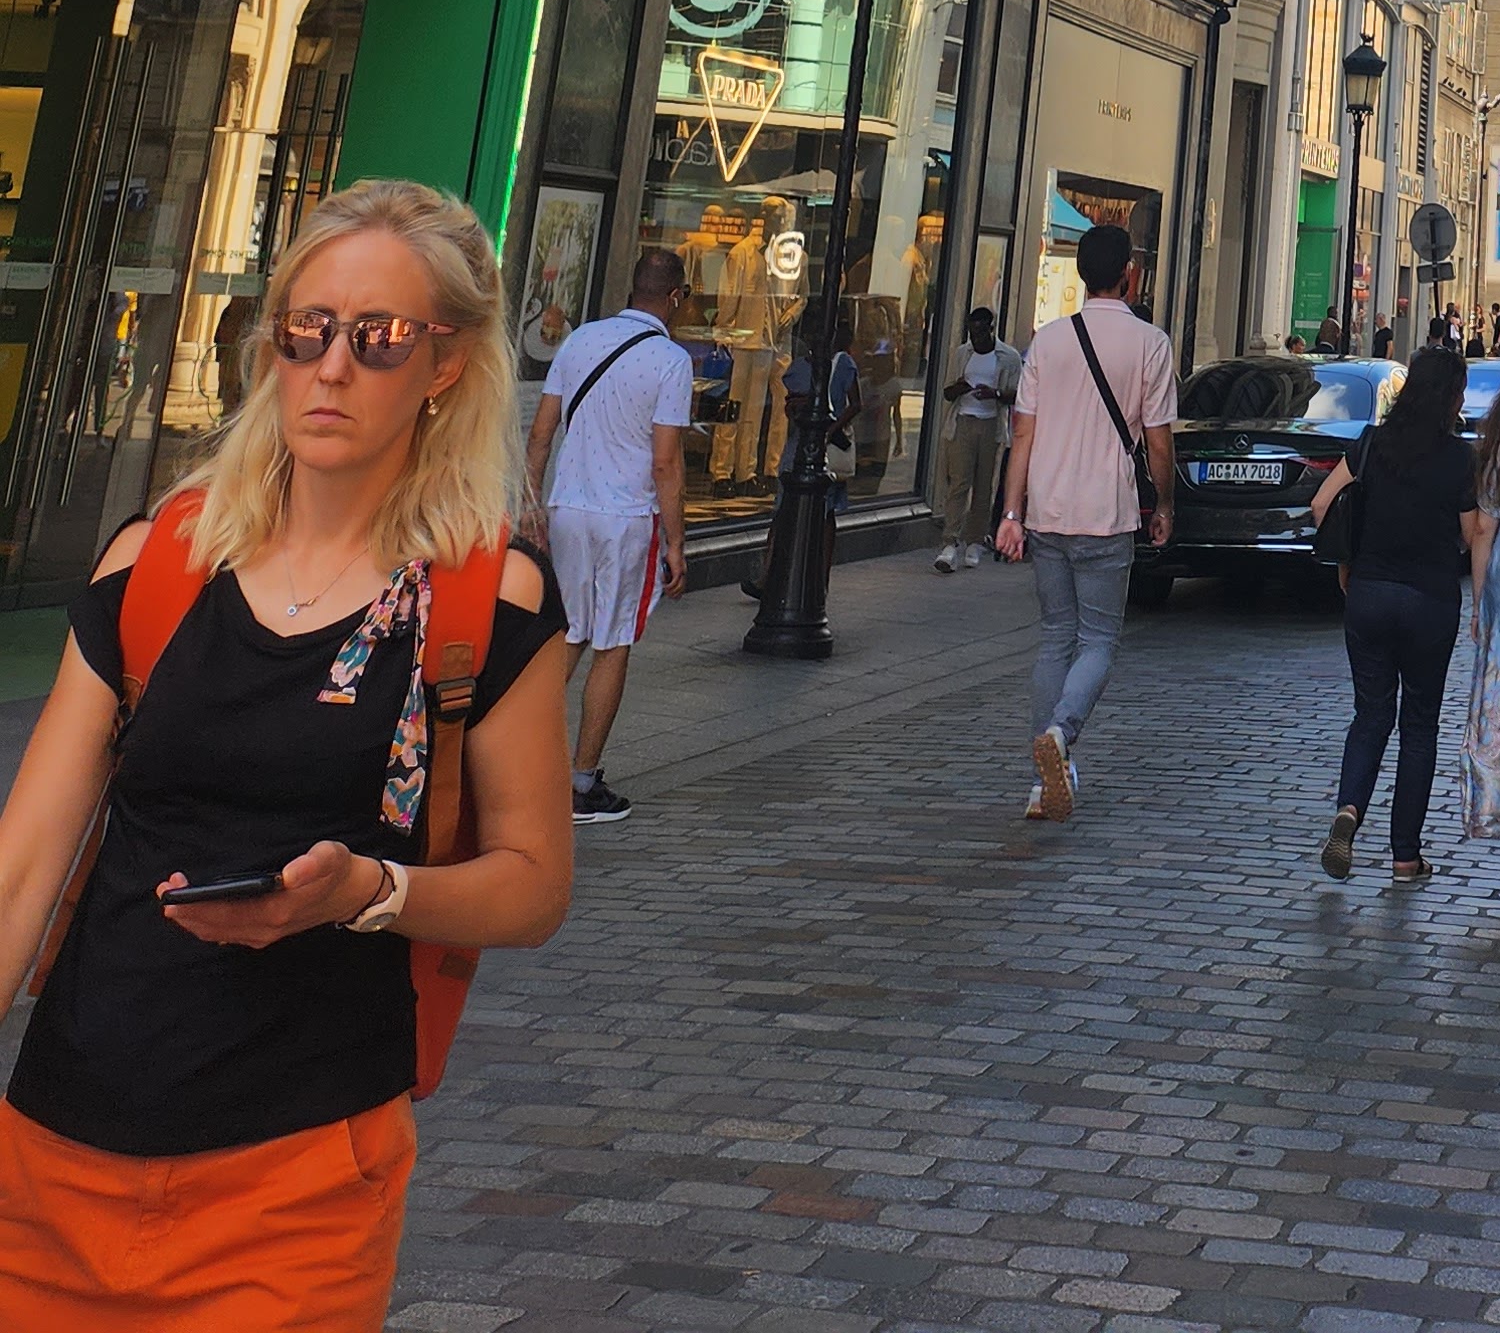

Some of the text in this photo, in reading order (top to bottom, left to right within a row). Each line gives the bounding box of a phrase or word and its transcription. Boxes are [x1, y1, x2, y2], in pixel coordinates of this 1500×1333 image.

[710, 74, 766, 110] PRADA
[1207, 464, 1281, 480] AC AX 7018
